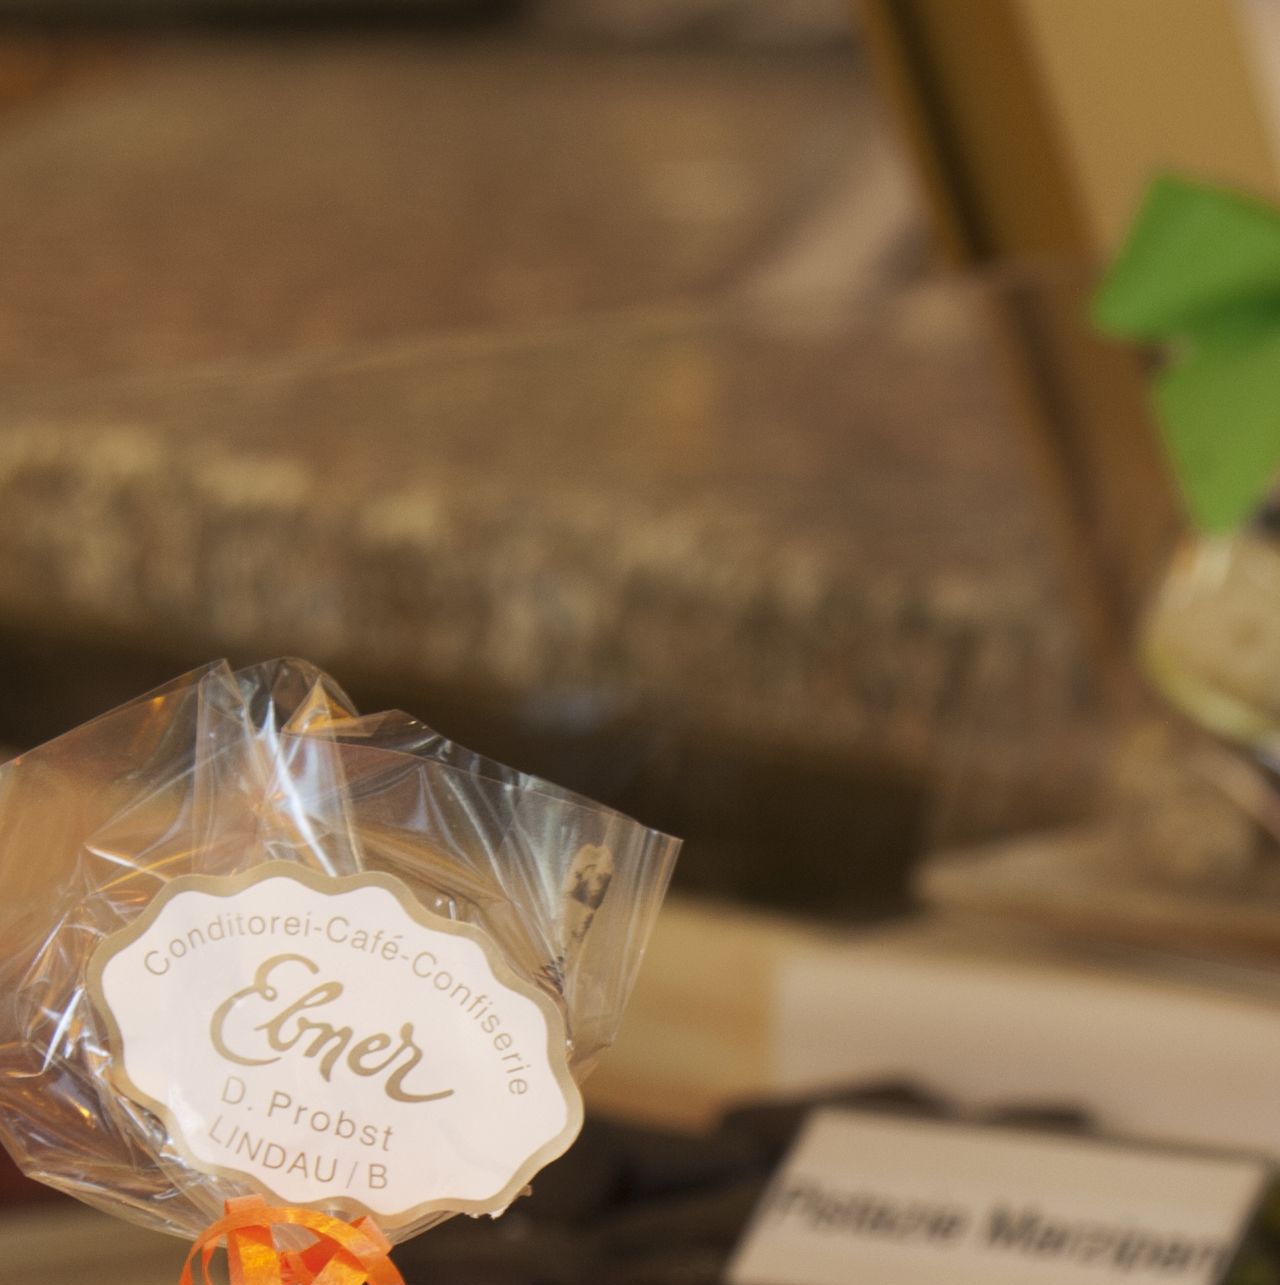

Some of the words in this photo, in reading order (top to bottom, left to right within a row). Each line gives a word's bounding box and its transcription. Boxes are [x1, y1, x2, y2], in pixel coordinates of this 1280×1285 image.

[143, 911, 530, 1097] Conditorei-Café-Confiserie
[209, 953, 455, 1103] Ebner
[221, 1075, 253, 1112] D.
[267, 1090, 394, 1152] Probst
